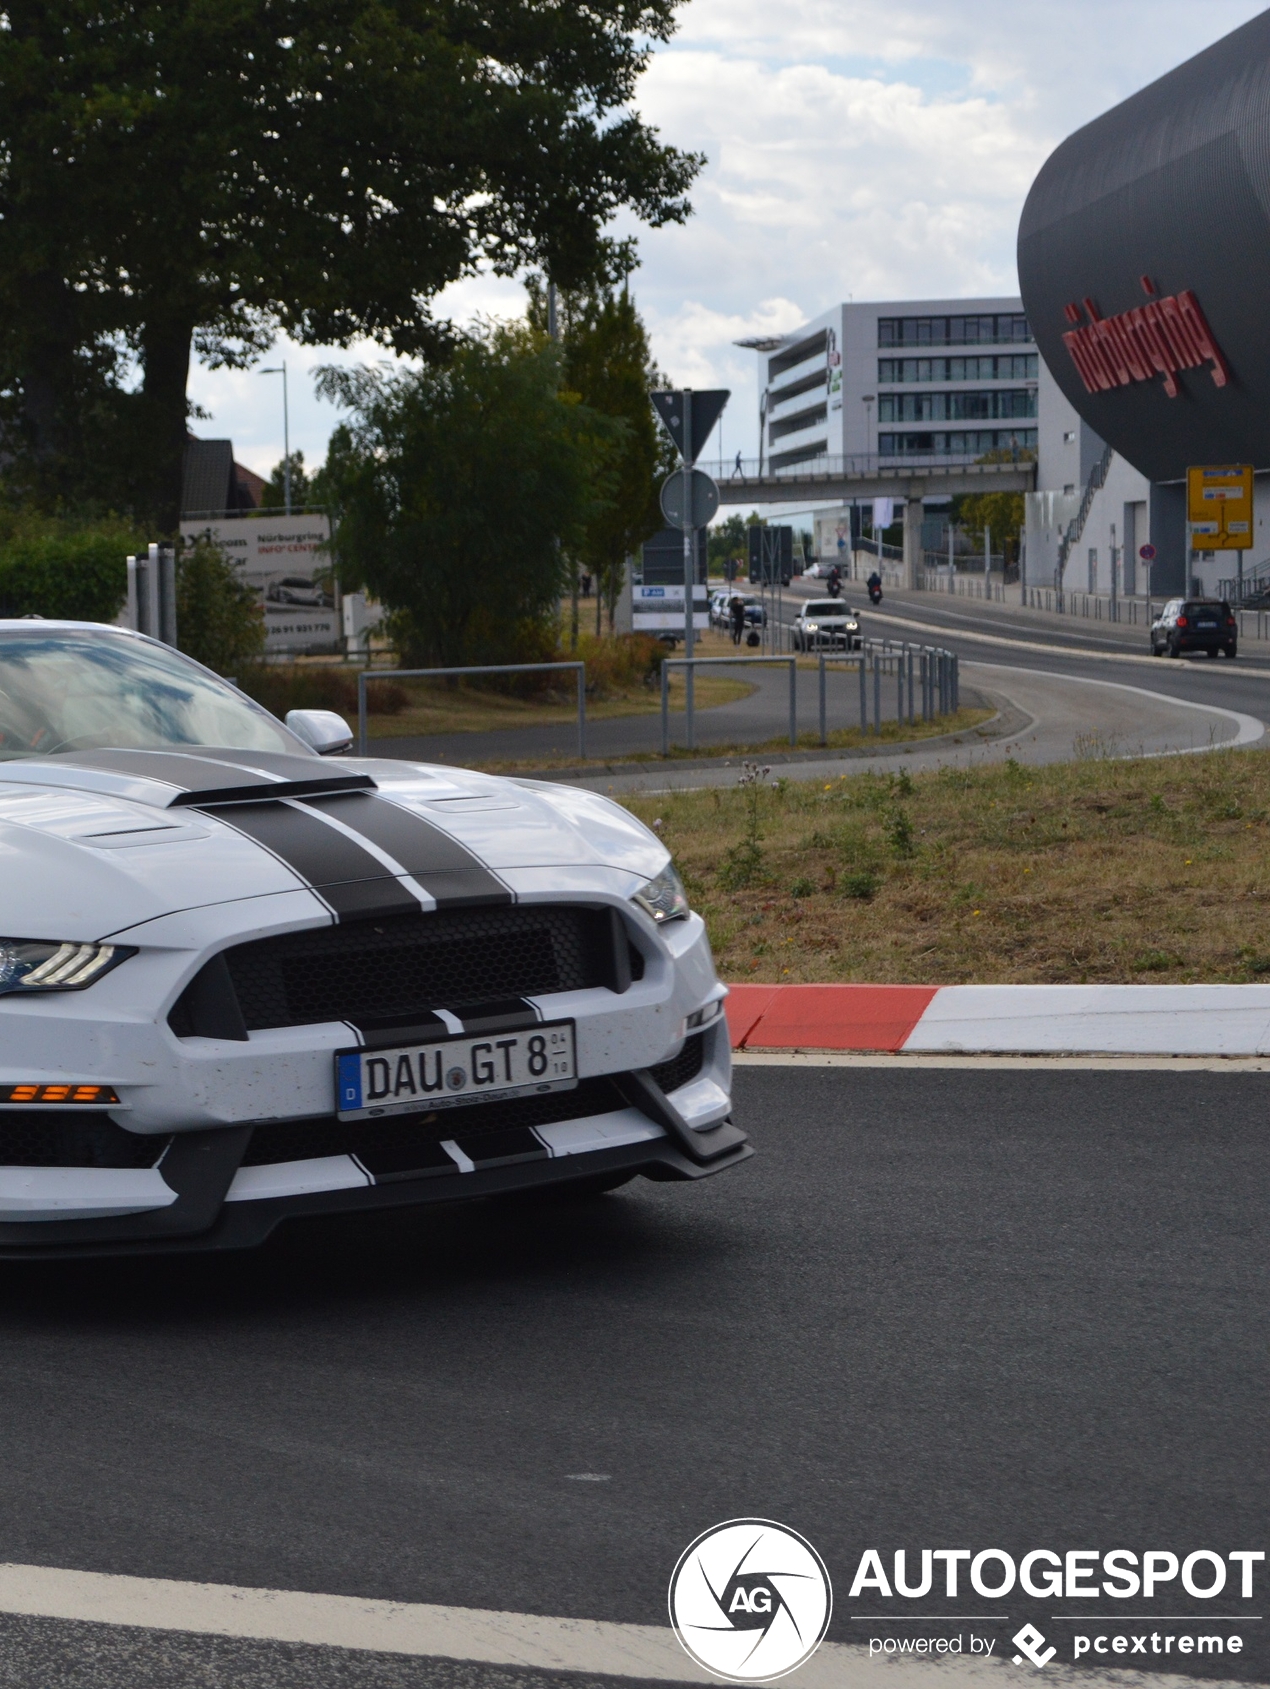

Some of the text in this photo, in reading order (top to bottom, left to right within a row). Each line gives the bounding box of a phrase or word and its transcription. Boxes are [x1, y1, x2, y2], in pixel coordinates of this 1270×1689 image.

[257, 531, 324, 543] Nürburgring
[346, 1035, 548, 1100] D DAU GT 8
